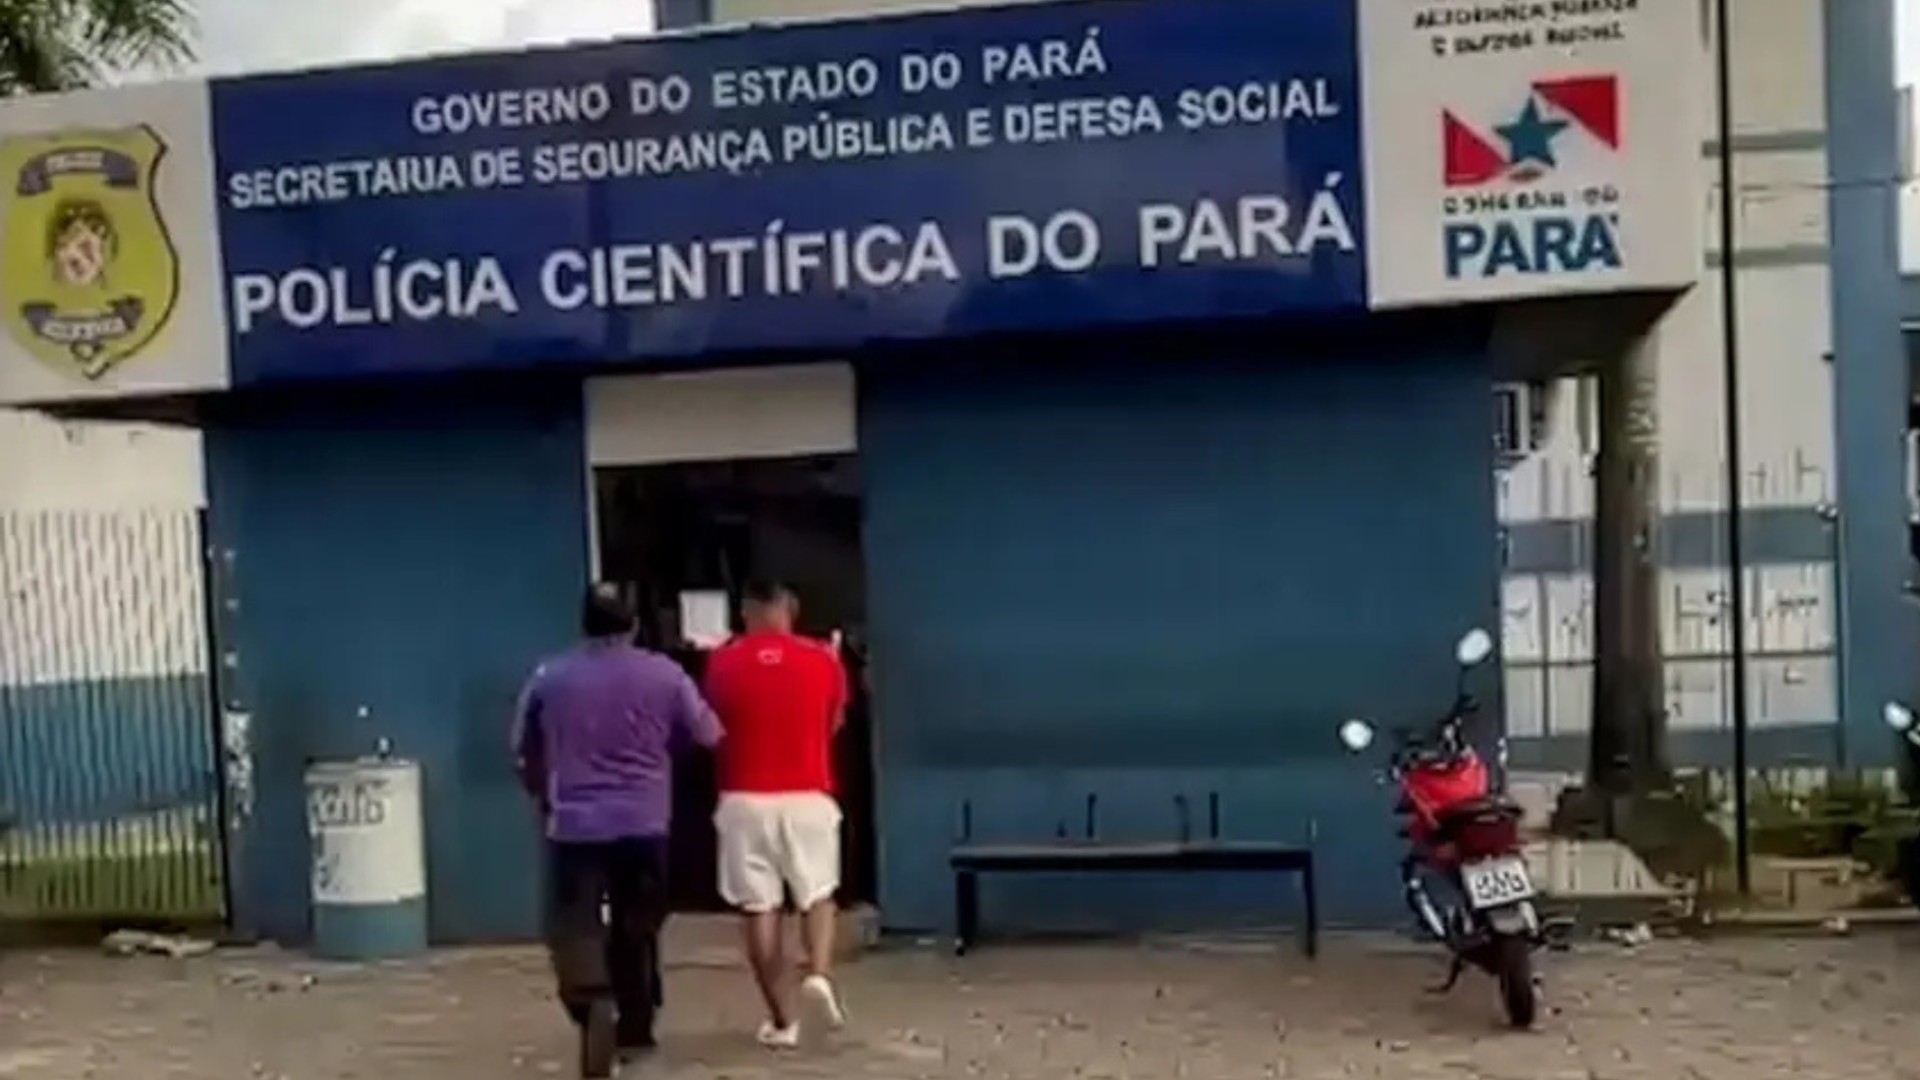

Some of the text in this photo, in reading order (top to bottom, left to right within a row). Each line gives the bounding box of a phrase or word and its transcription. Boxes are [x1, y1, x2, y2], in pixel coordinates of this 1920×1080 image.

[412, 28, 1106, 134] GOVERNO DO ESTADO DO PARÁ
[473, 149, 523, 187] DE
[783, 112, 953, 163] PÚBLICA
[968, 109, 994, 147] E
[1005, 97, 1163, 143] DEFESA
[1179, 78, 1340, 128] SOCIAL
[233, 172, 1354, 333] POLÍCIA CIENTÍFICA DO PARÁ
